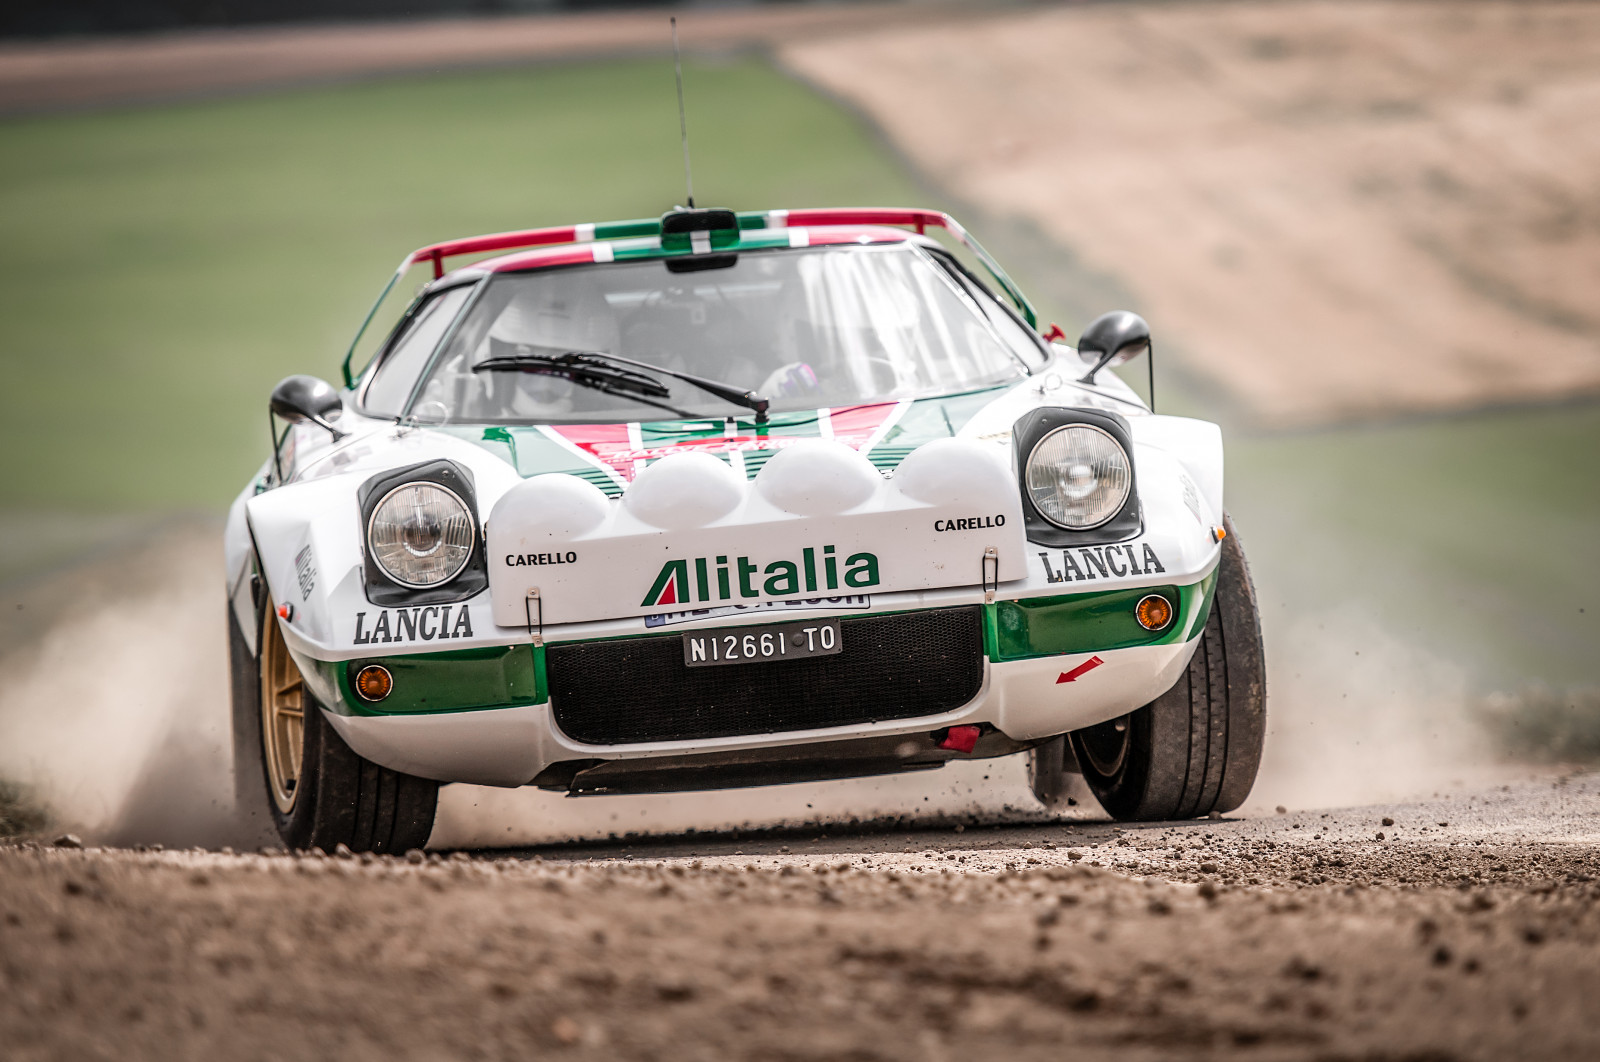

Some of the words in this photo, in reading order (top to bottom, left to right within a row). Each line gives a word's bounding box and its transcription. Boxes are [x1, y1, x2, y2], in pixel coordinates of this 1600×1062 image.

[934, 514, 1006, 532] CARELLO
[505, 551, 578, 567] CARELLO
[640, 545, 880, 607] Alitalia
[1038, 543, 1166, 584] LANCIA
[353, 604, 474, 645] LANCIA
[690, 632, 786, 662] N12661
[802, 625, 835, 652] TO
